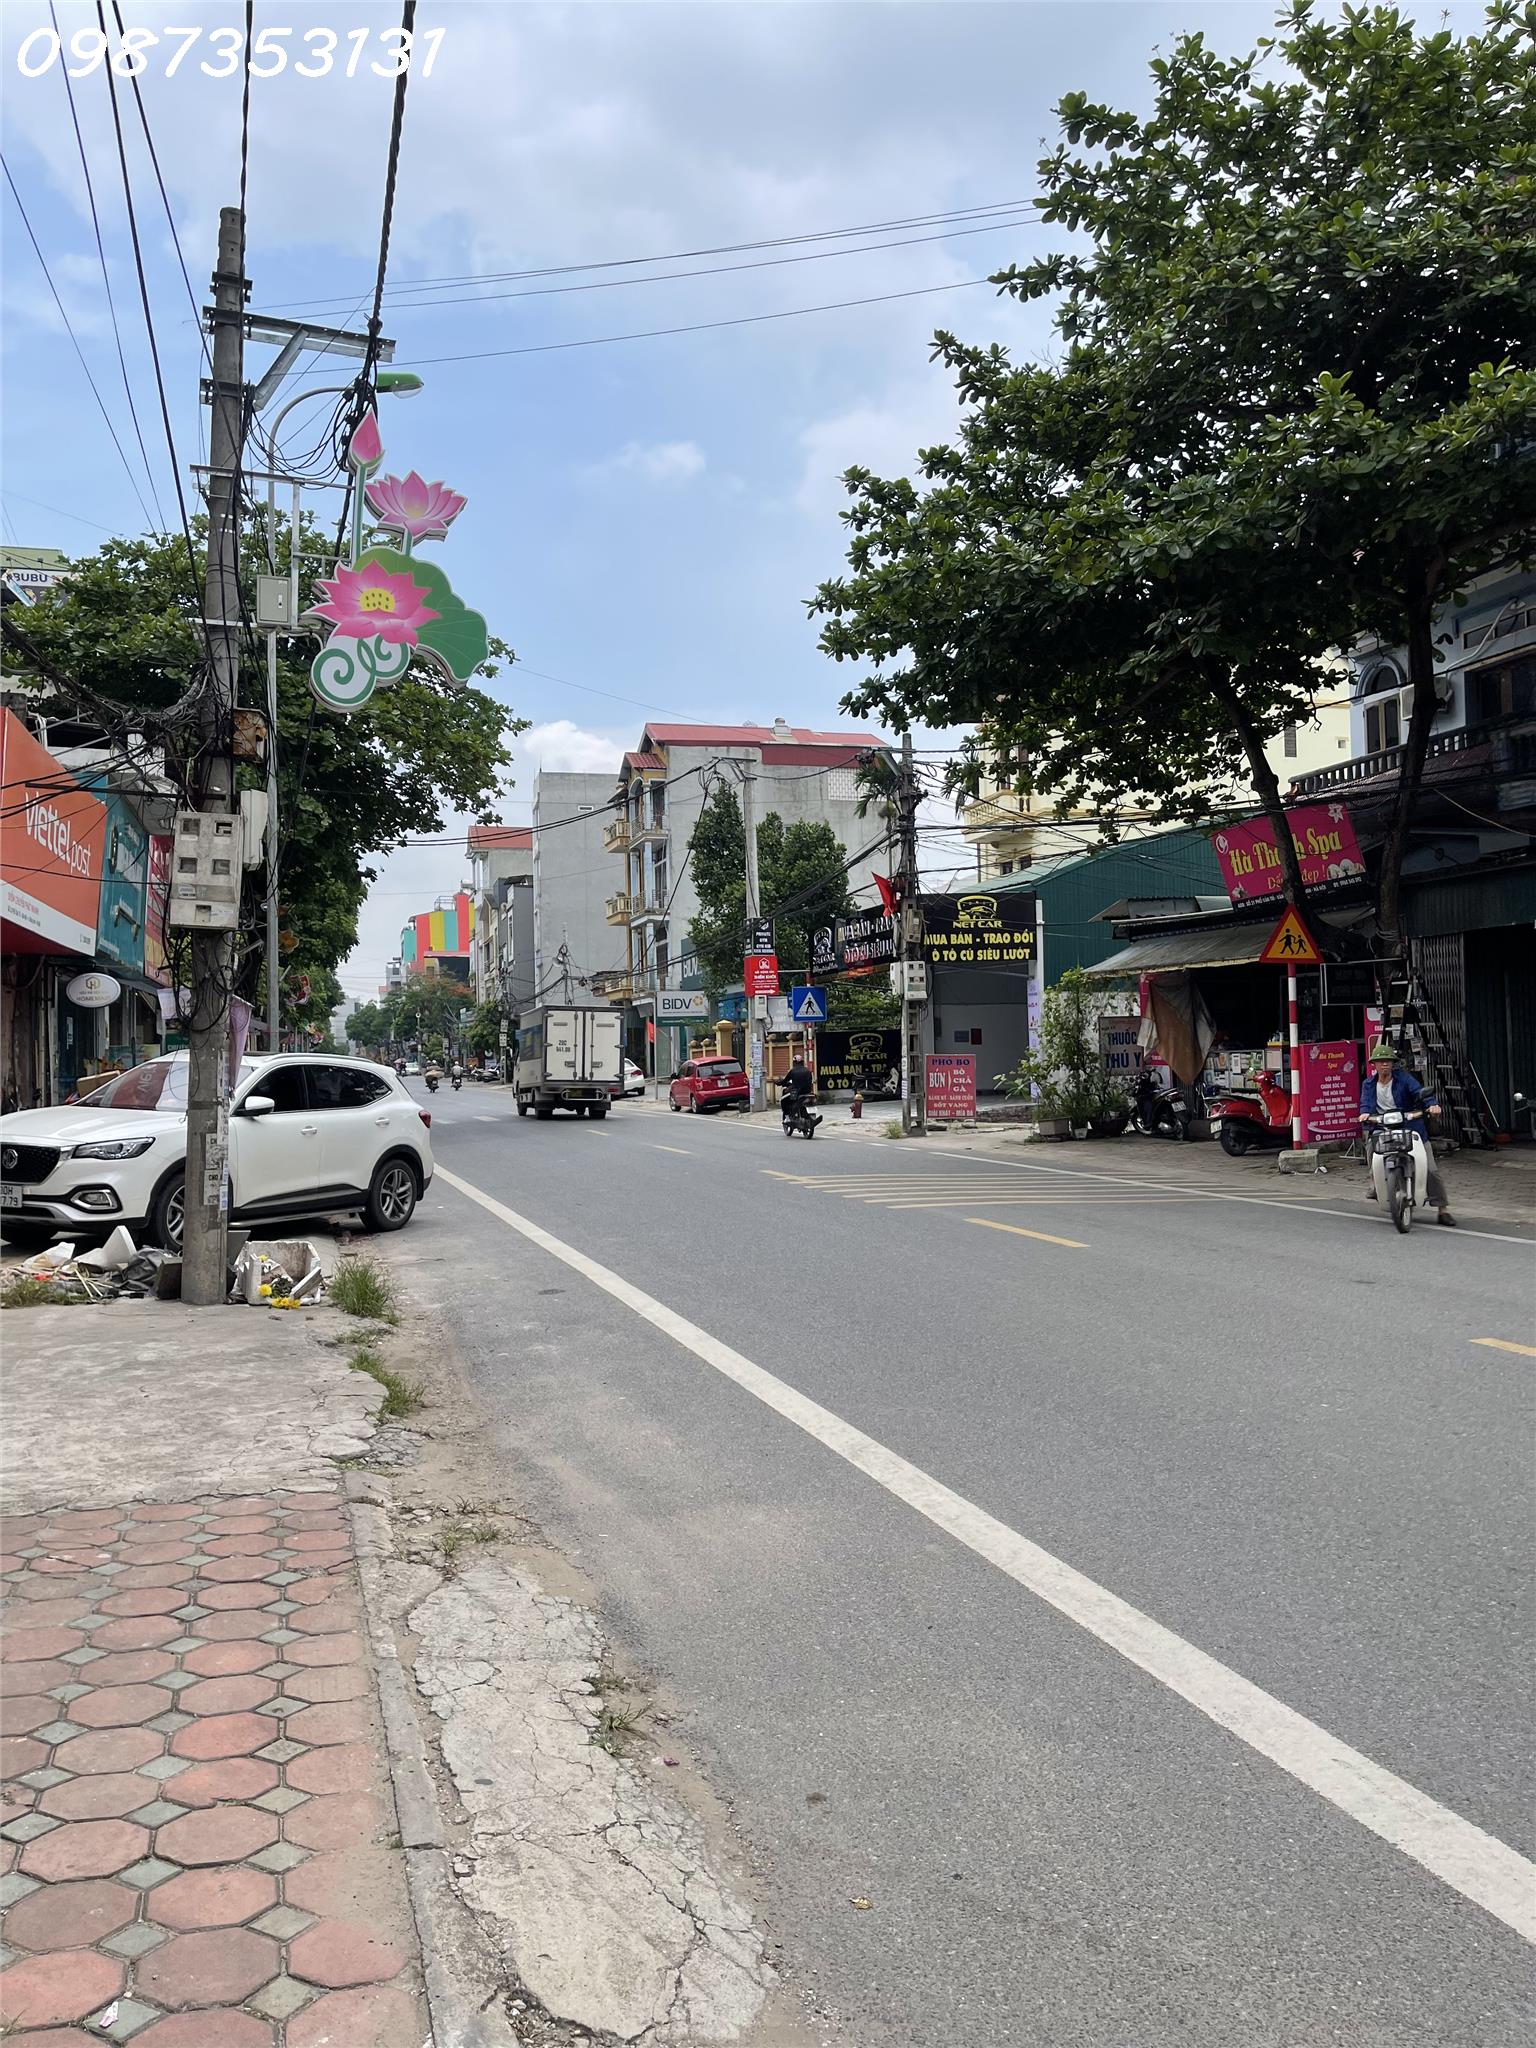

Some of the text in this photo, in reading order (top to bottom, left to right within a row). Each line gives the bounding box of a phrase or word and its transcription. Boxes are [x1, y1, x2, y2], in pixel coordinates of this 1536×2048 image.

[1229, 848, 1255, 876] Hà
[1306, 827, 1343, 860] Spa
[70, 841, 91, 877] post
[977, 920, 1003, 928] CAR
[983, 932, 1011, 944] TRAO
[932, 948, 940, 961] Ô
[942, 948, 957, 961] TÔ
[977, 947, 1000, 960] SIÊU
[662, 998, 692, 1010] BIDV
[1133, 1051, 1142, 1068] Y
[820, 1065, 841, 1076] MUA
[827, 1077, 835, 1089] Ô
[836, 1077, 850, 1089] TÔ
[929, 1067, 946, 1088] BÚN
